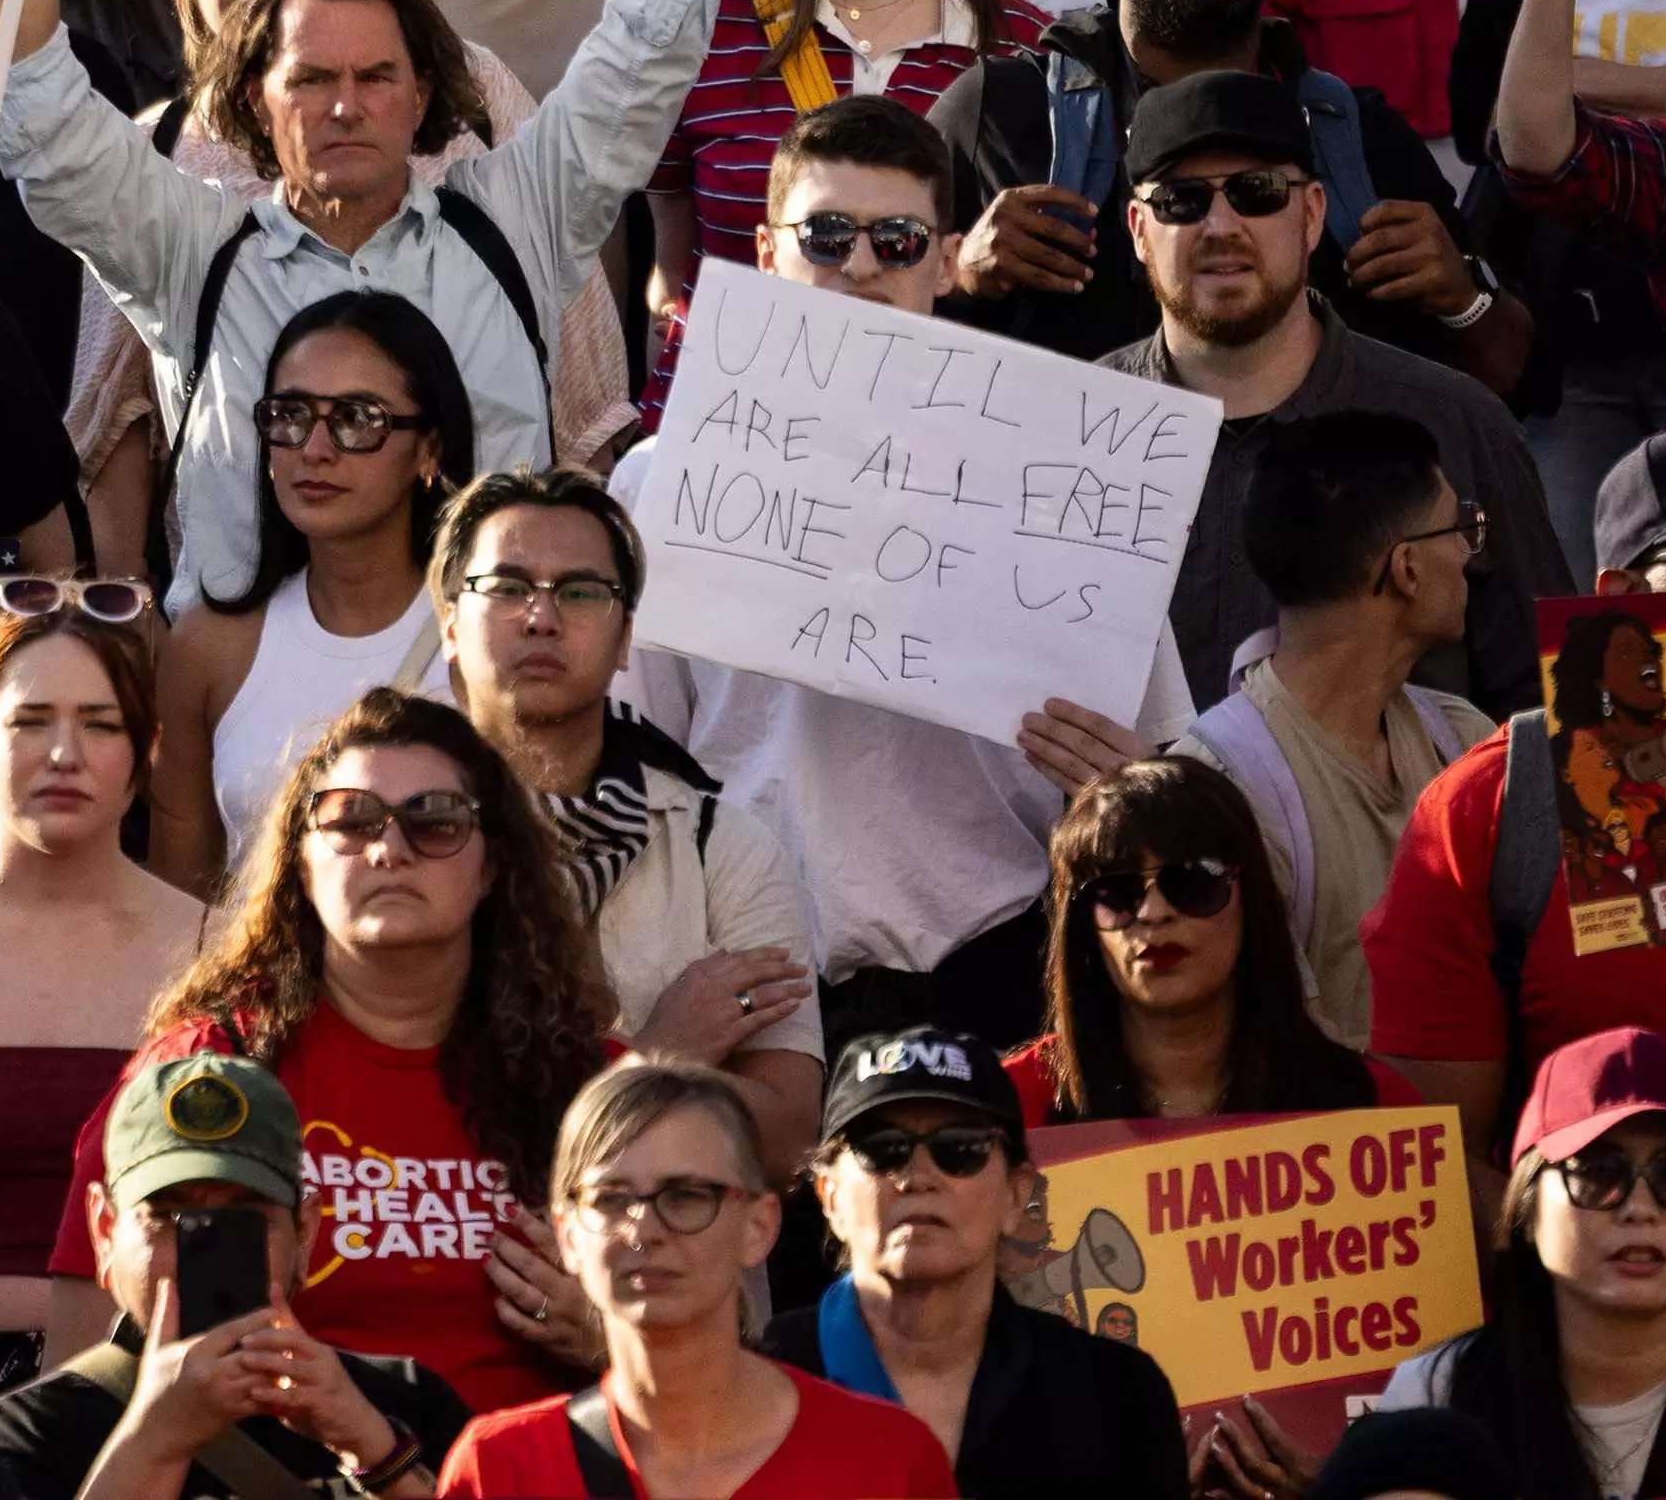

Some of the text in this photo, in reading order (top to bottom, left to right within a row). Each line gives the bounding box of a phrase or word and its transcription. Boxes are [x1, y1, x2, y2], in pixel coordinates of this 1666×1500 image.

[715, 287, 1188, 462] UNTIL WE
[691, 389, 1173, 548] ARE ALL FREE
[674, 463, 1101, 625] NONE OF US
[790, 606, 938, 685] ARE.
[857, 1040, 969, 1082] LOVE
[301, 1151, 511, 1191] ABORTIO
[334, 1187, 517, 1223] HEALT
[1146, 1123, 1447, 1235] HANDS OFF
[333, 1221, 495, 1260] CARE
[1185, 1200, 1437, 1302] Workers'
[1240, 1295, 1423, 1373] Voices
